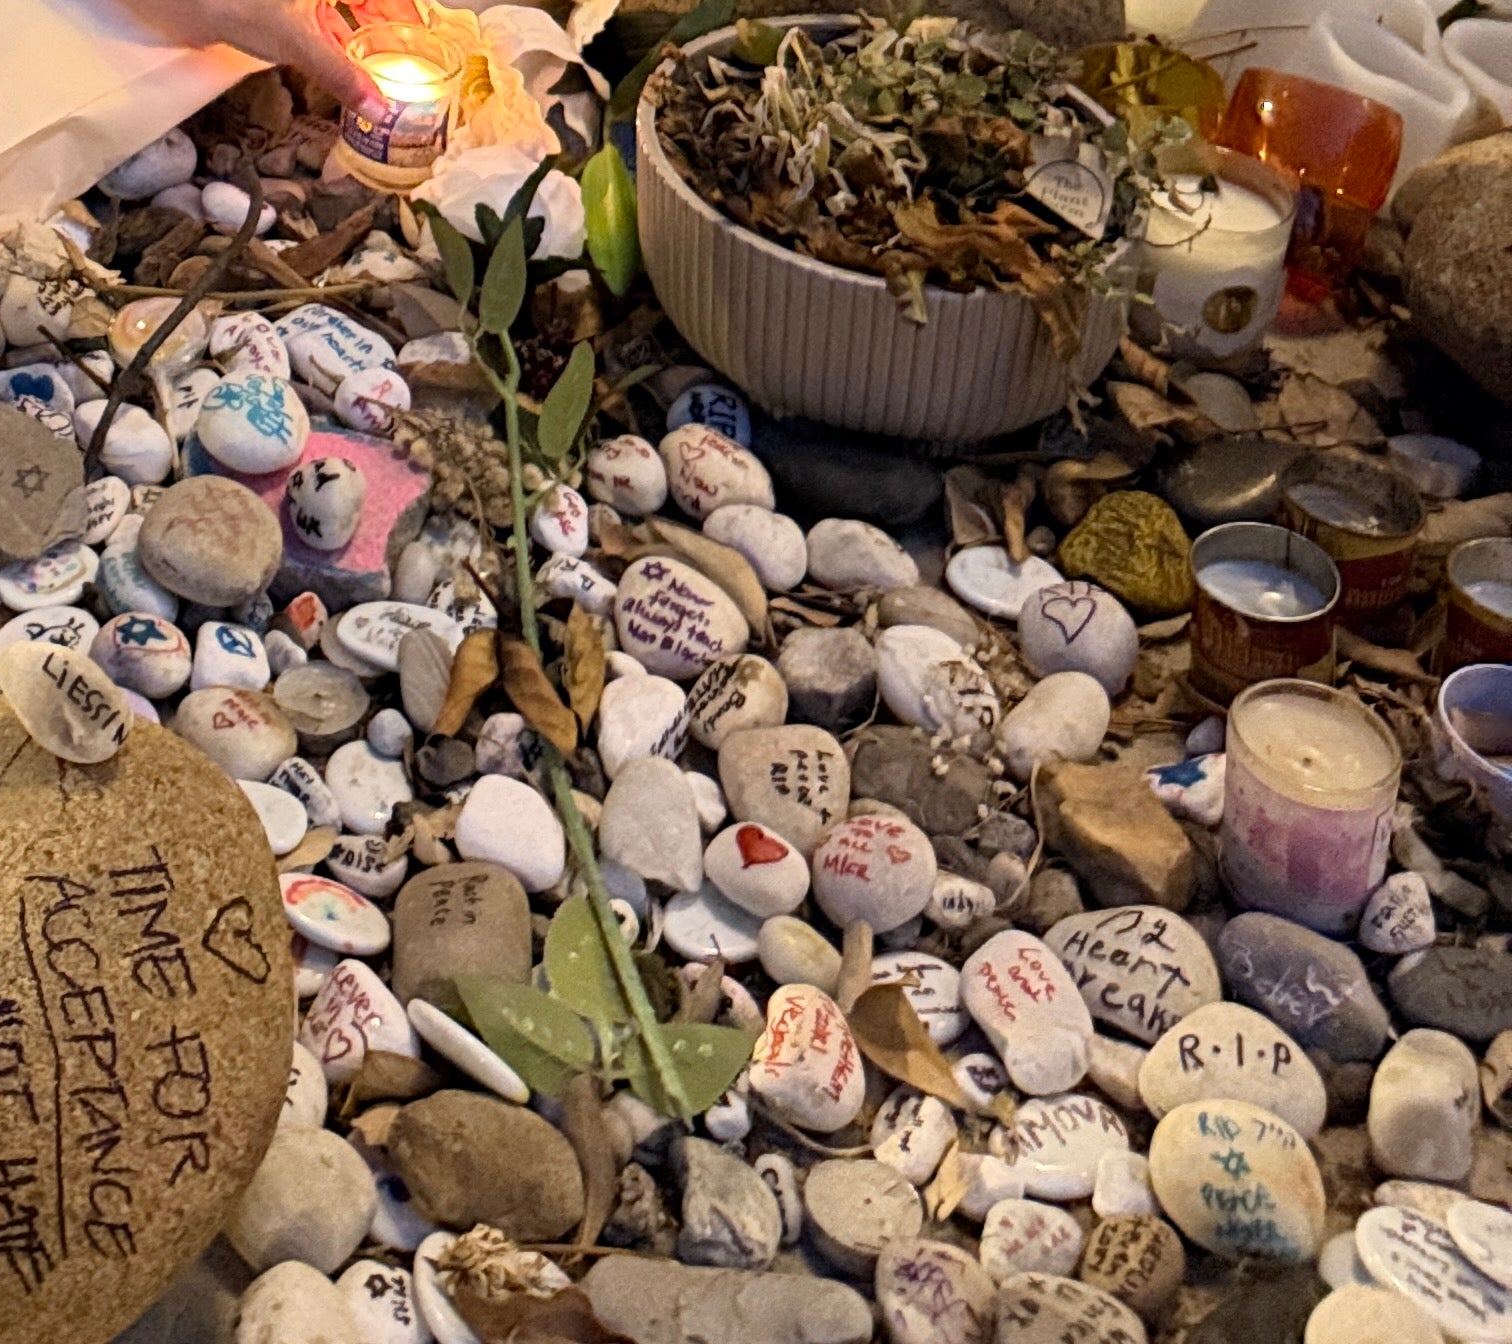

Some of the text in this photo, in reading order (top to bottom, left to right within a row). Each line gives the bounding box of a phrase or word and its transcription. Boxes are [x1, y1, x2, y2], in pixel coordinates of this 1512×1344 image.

[107, 843, 198, 1000] TIME
[24, 873, 138, 1260] ACCEPTANCE
[144, 1024, 212, 1188] FOR
